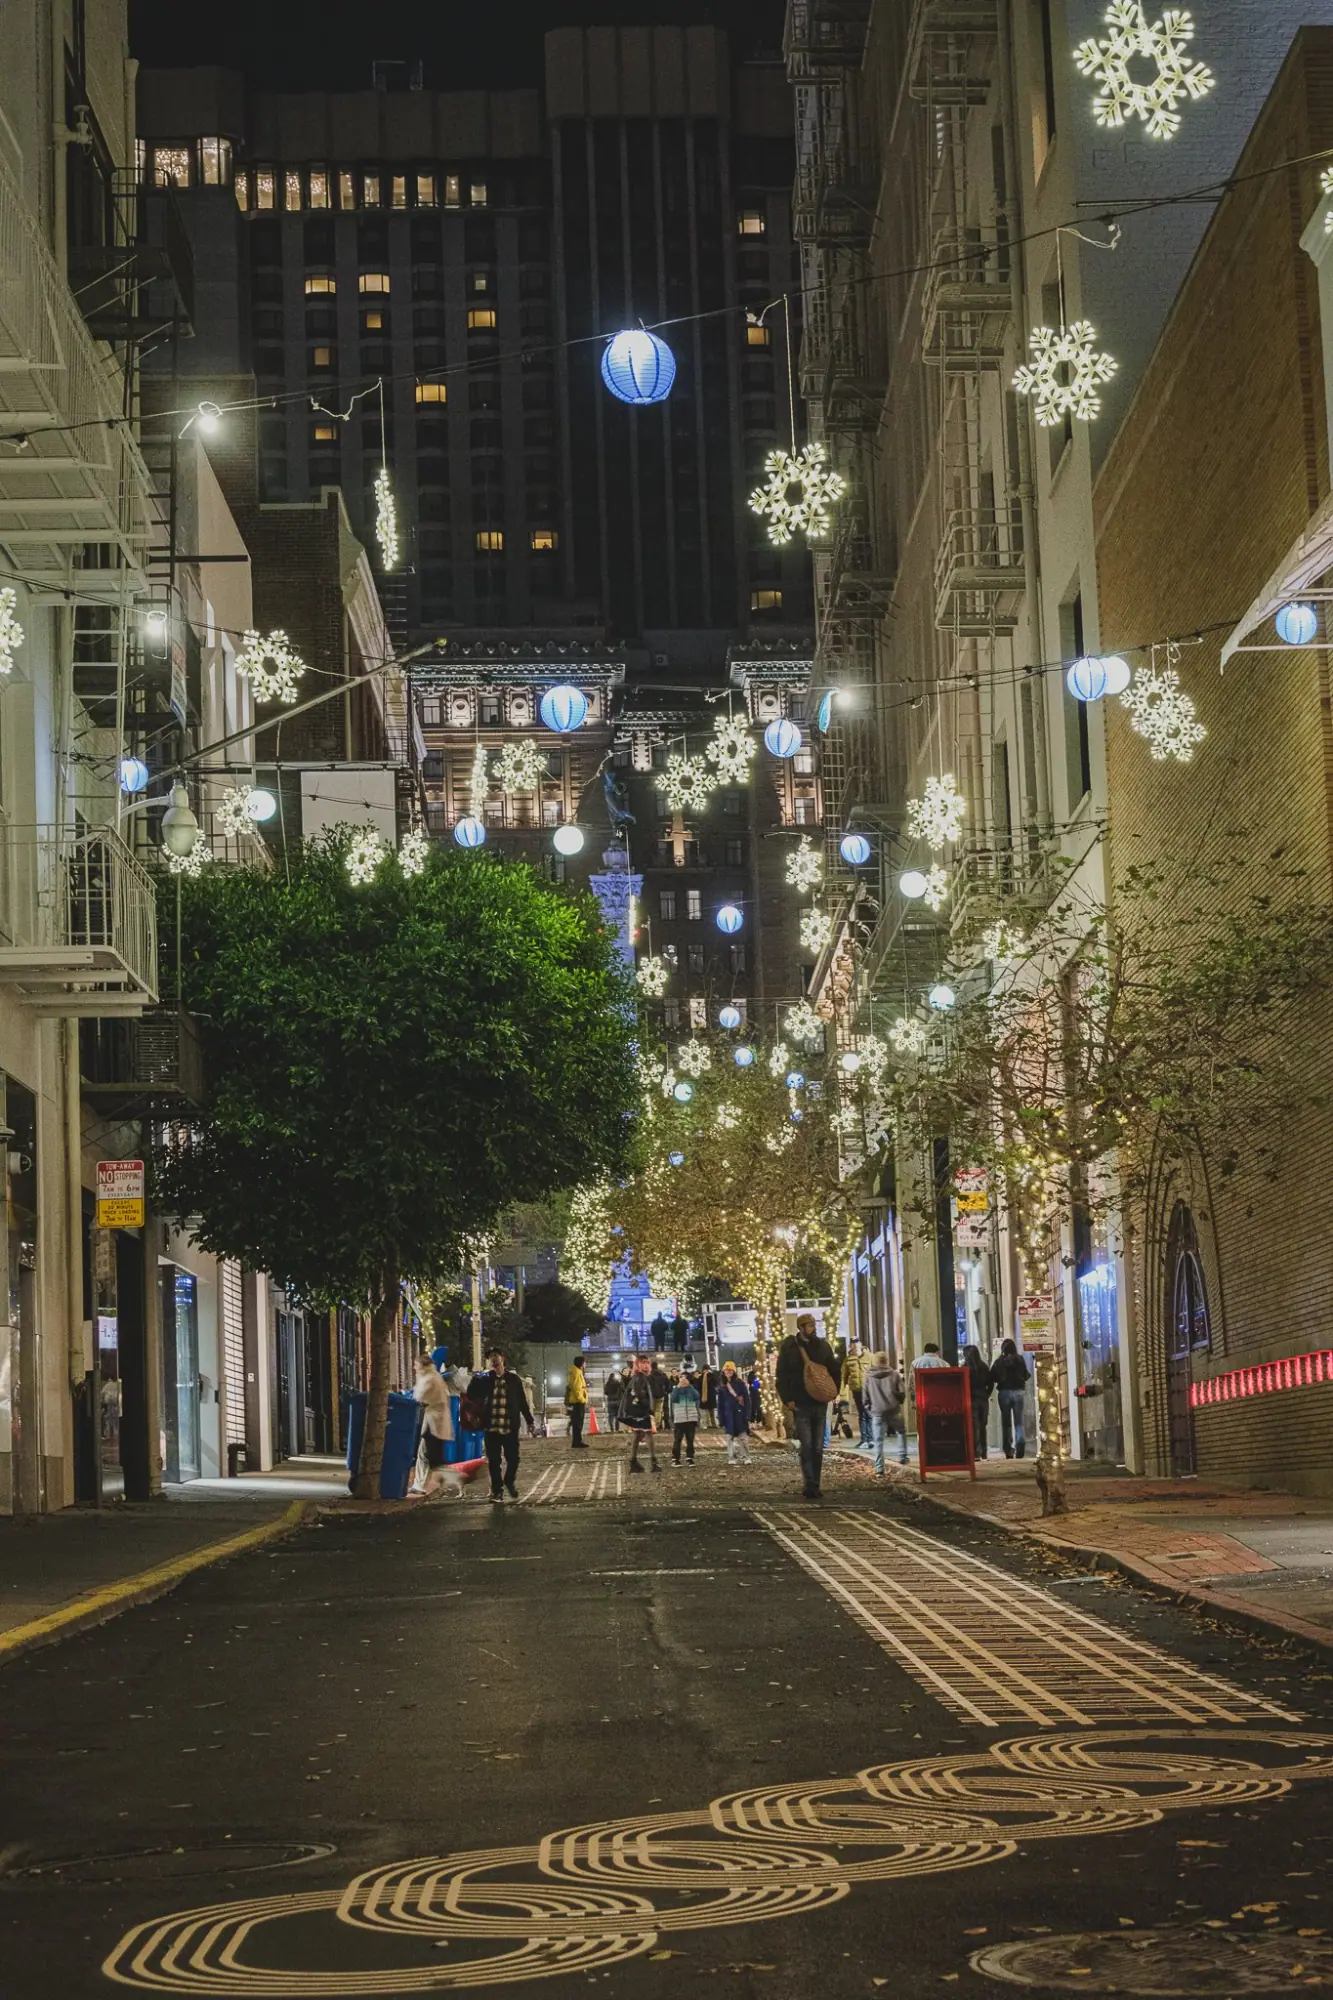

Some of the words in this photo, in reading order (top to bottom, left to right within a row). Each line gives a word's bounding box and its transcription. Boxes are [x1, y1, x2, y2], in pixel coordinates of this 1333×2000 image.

[100, 1171, 114, 1184] NO
[115, 1172, 141, 1180] STOPPING
[103, 1184, 114, 1192] 7AM
[126, 1184, 140, 1192] 6PM
